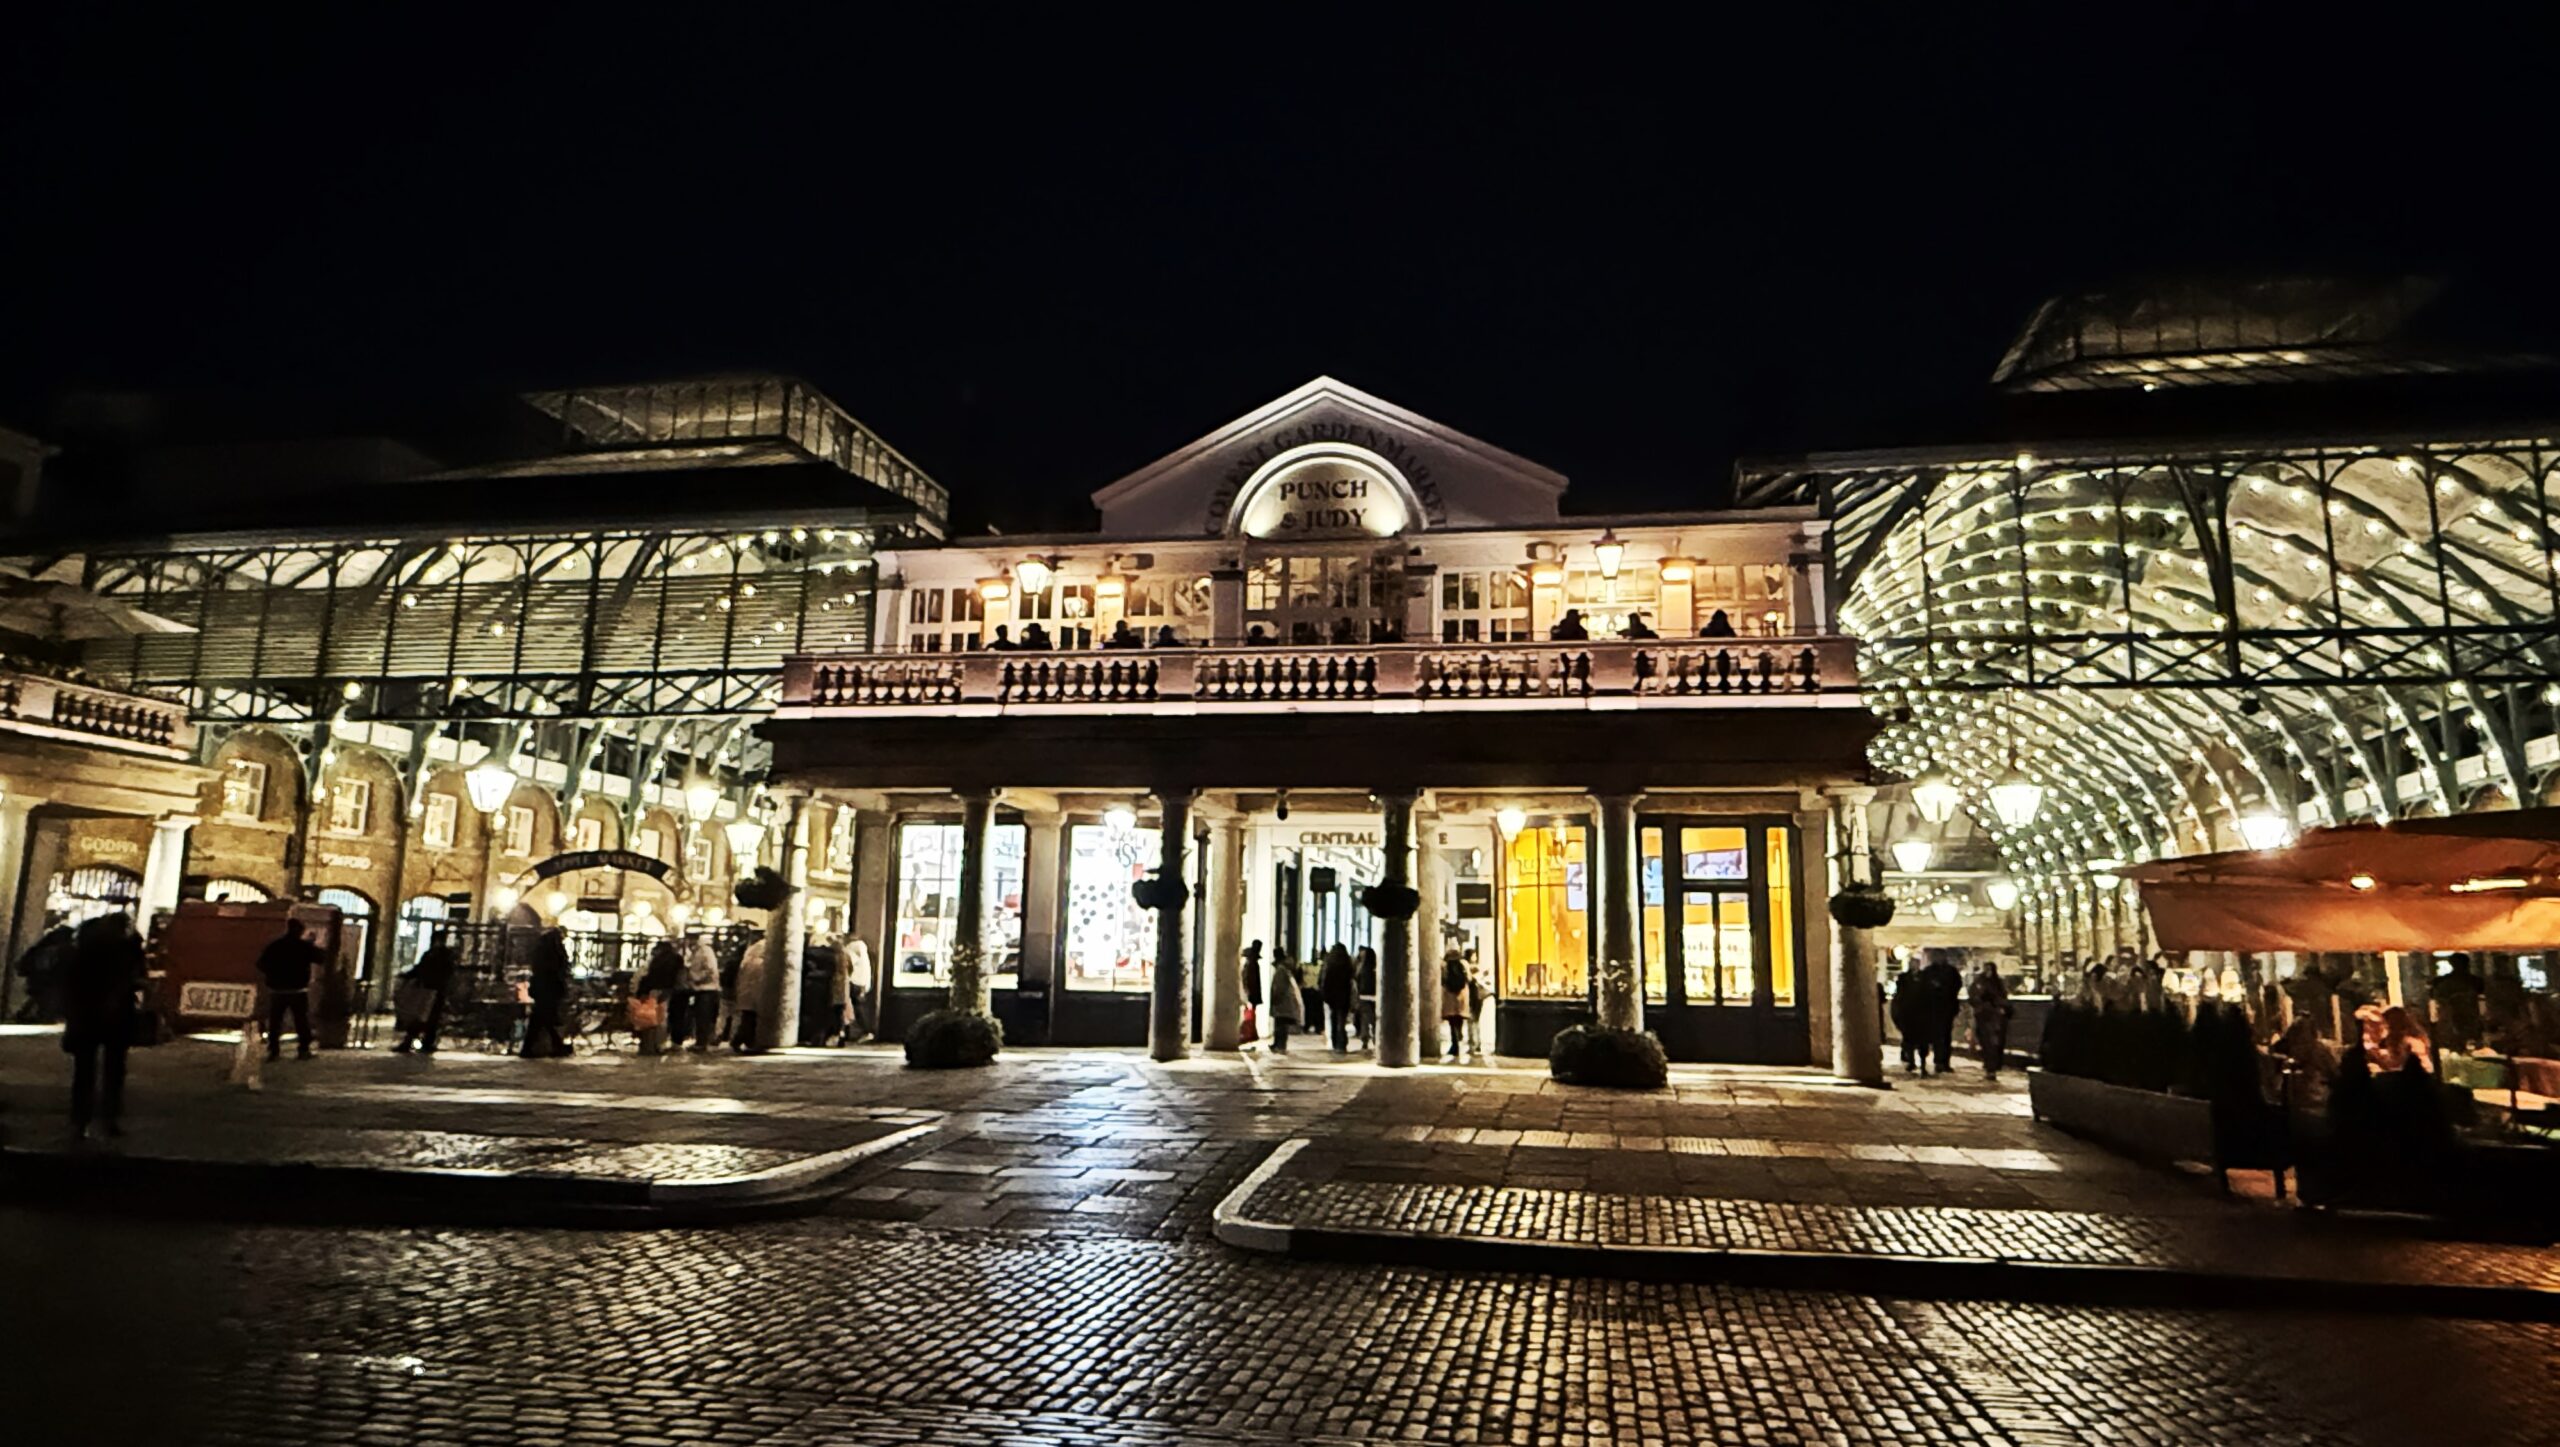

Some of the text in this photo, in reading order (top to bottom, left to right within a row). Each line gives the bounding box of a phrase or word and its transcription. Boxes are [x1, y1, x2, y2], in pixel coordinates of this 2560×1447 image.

[1205, 423, 1446, 535] COVENT GARDEN MARKET
[1280, 480, 1368, 500] PUNCH
[1280, 508, 1368, 531] & JUDY
[1299, 831, 1378, 845] CENTRAL
